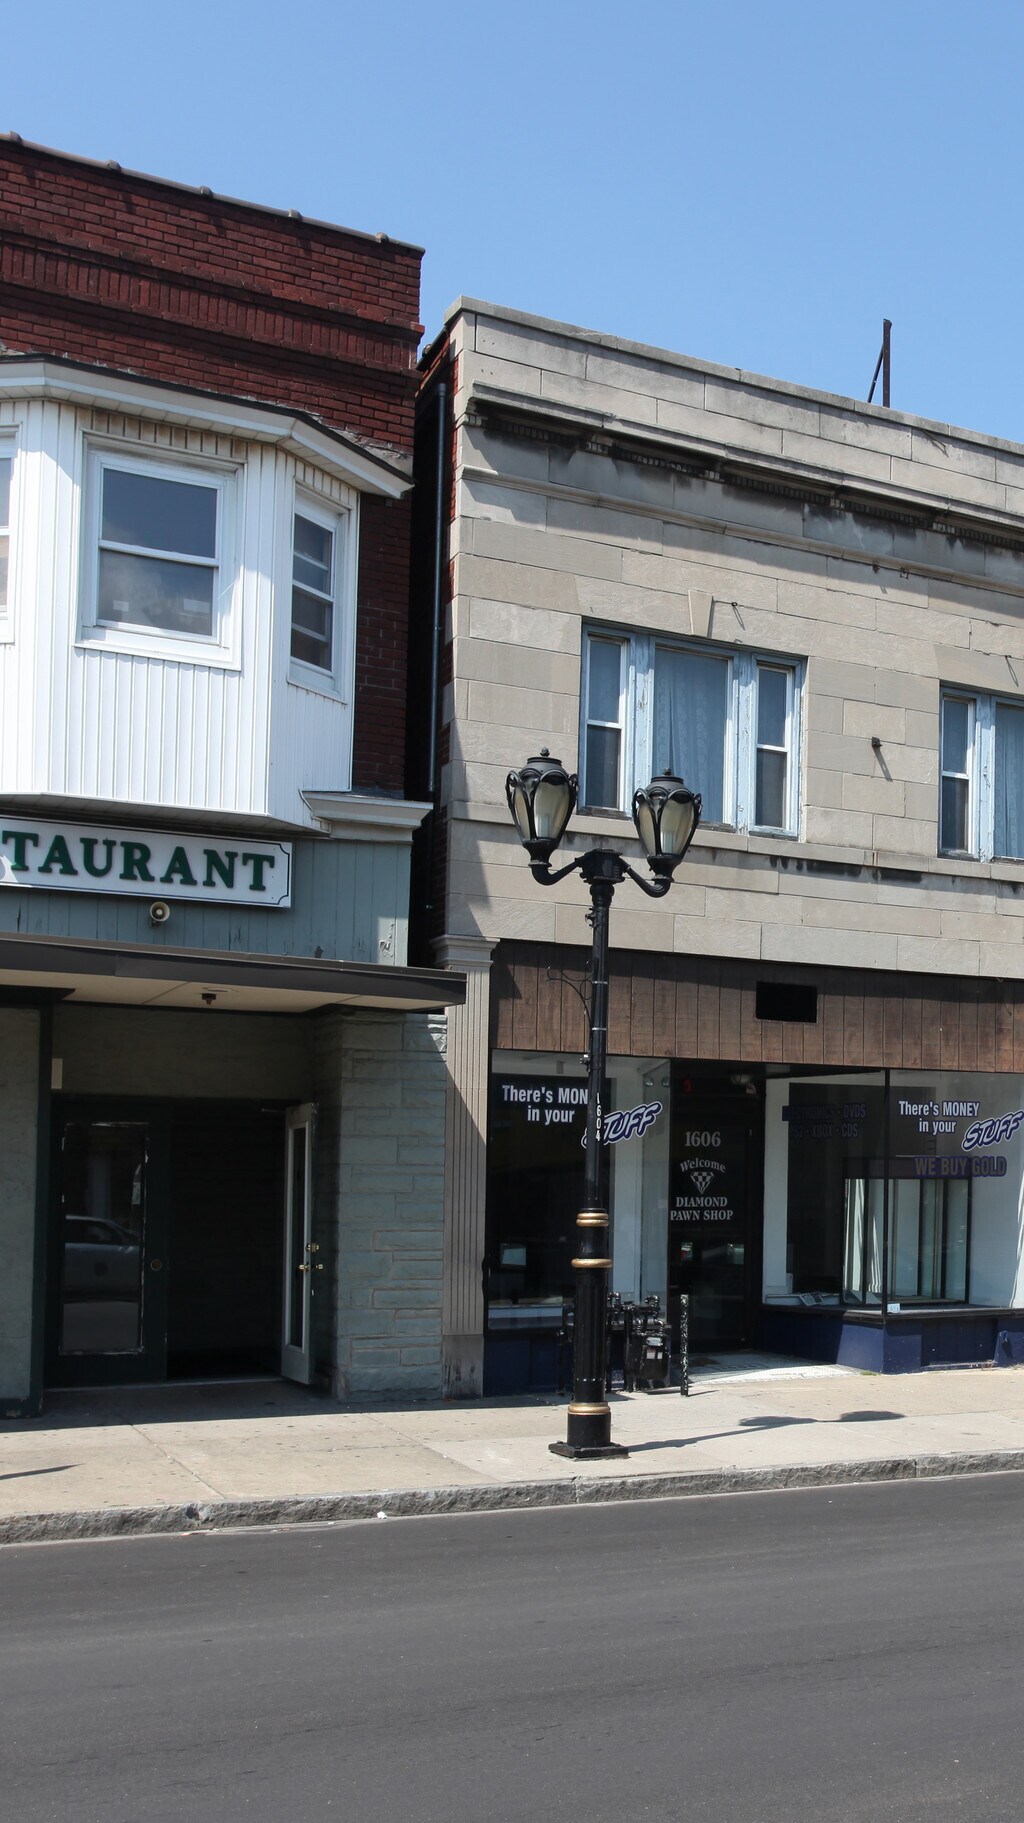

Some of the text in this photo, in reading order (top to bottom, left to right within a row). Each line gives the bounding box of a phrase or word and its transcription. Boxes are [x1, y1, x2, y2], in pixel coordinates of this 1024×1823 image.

[2, 831, 275, 891] TAURANT
[502, 1085, 588, 1104] There's MON
[843, 1104, 866, 1118] DVDS
[898, 1100, 979, 1116] There's MONEY
[527, 1101, 663, 1149] in your TUFF
[841, 1122, 859, 1137] CDS
[919, 1109, 1024, 1152] in your STUFF
[685, 1131, 721, 1147] 1606
[680, 1157, 726, 1173] Welcome
[914, 1157, 1007, 1177] WE BUY GOLD
[676, 1196, 728, 1207] DIAMOND
[670, 1209, 733, 1221] PAWN SHOP
